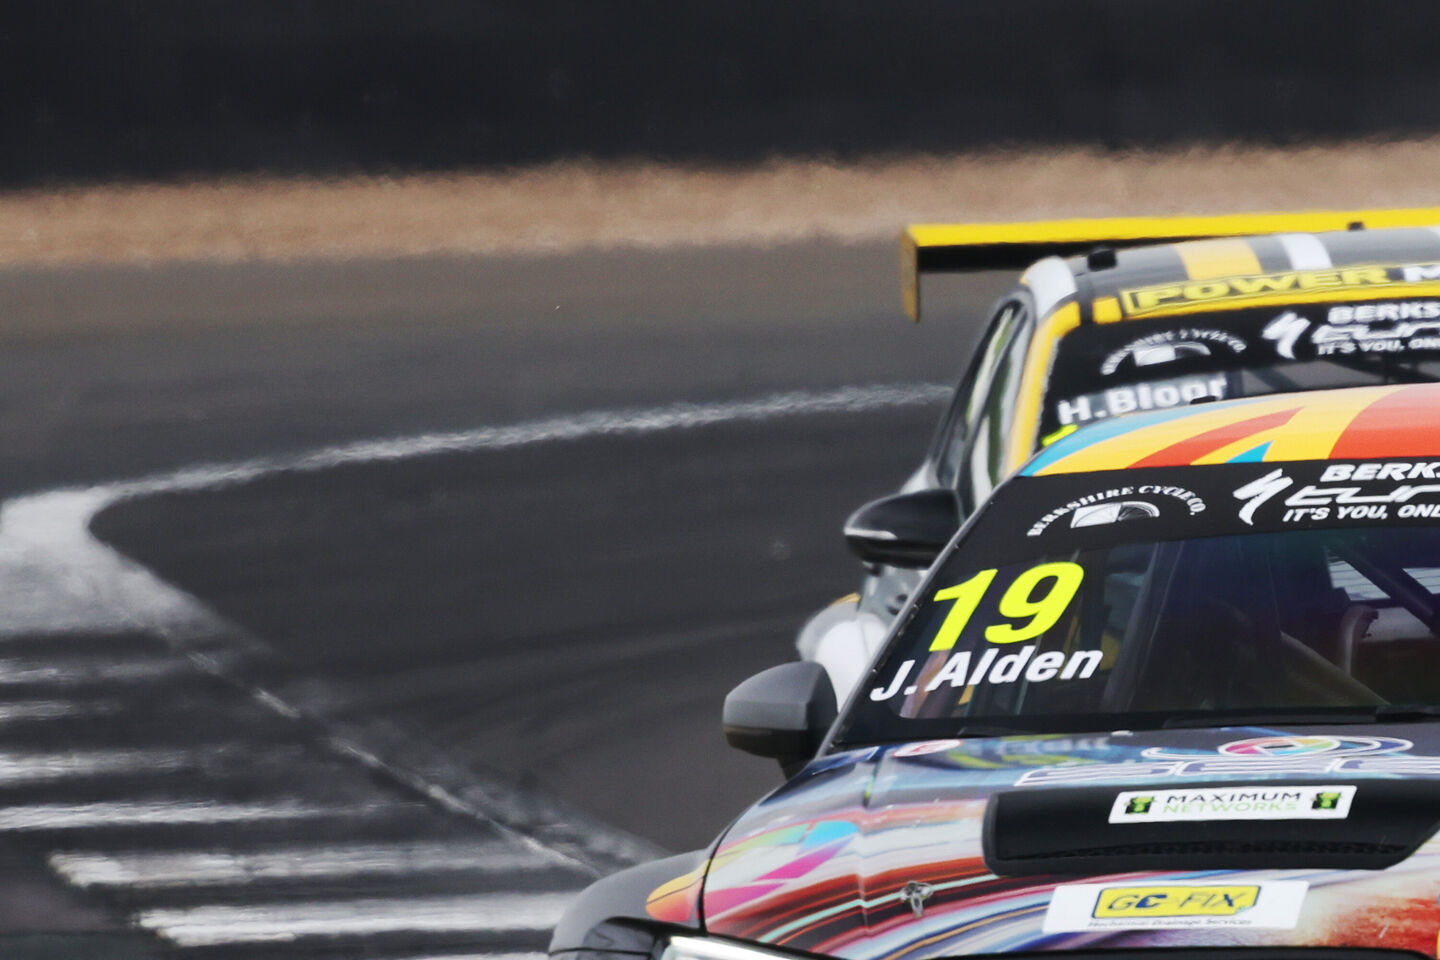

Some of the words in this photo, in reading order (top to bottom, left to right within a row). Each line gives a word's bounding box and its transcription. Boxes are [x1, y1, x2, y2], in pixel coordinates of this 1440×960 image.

[1137, 266, 1391, 309] POWER
[1026, 486, 1135, 537] BERKSHIRE
[1282, 505, 1331, 523] IT'S
[1336, 505, 1389, 520] YOU,
[928, 561, 1085, 652] 19
[869, 659, 919, 702] J.
[924, 645, 1104, 693] Alden
[1162, 801, 1298, 814] NETWORKS
[1166, 792, 1302, 804] MAXIMUM
